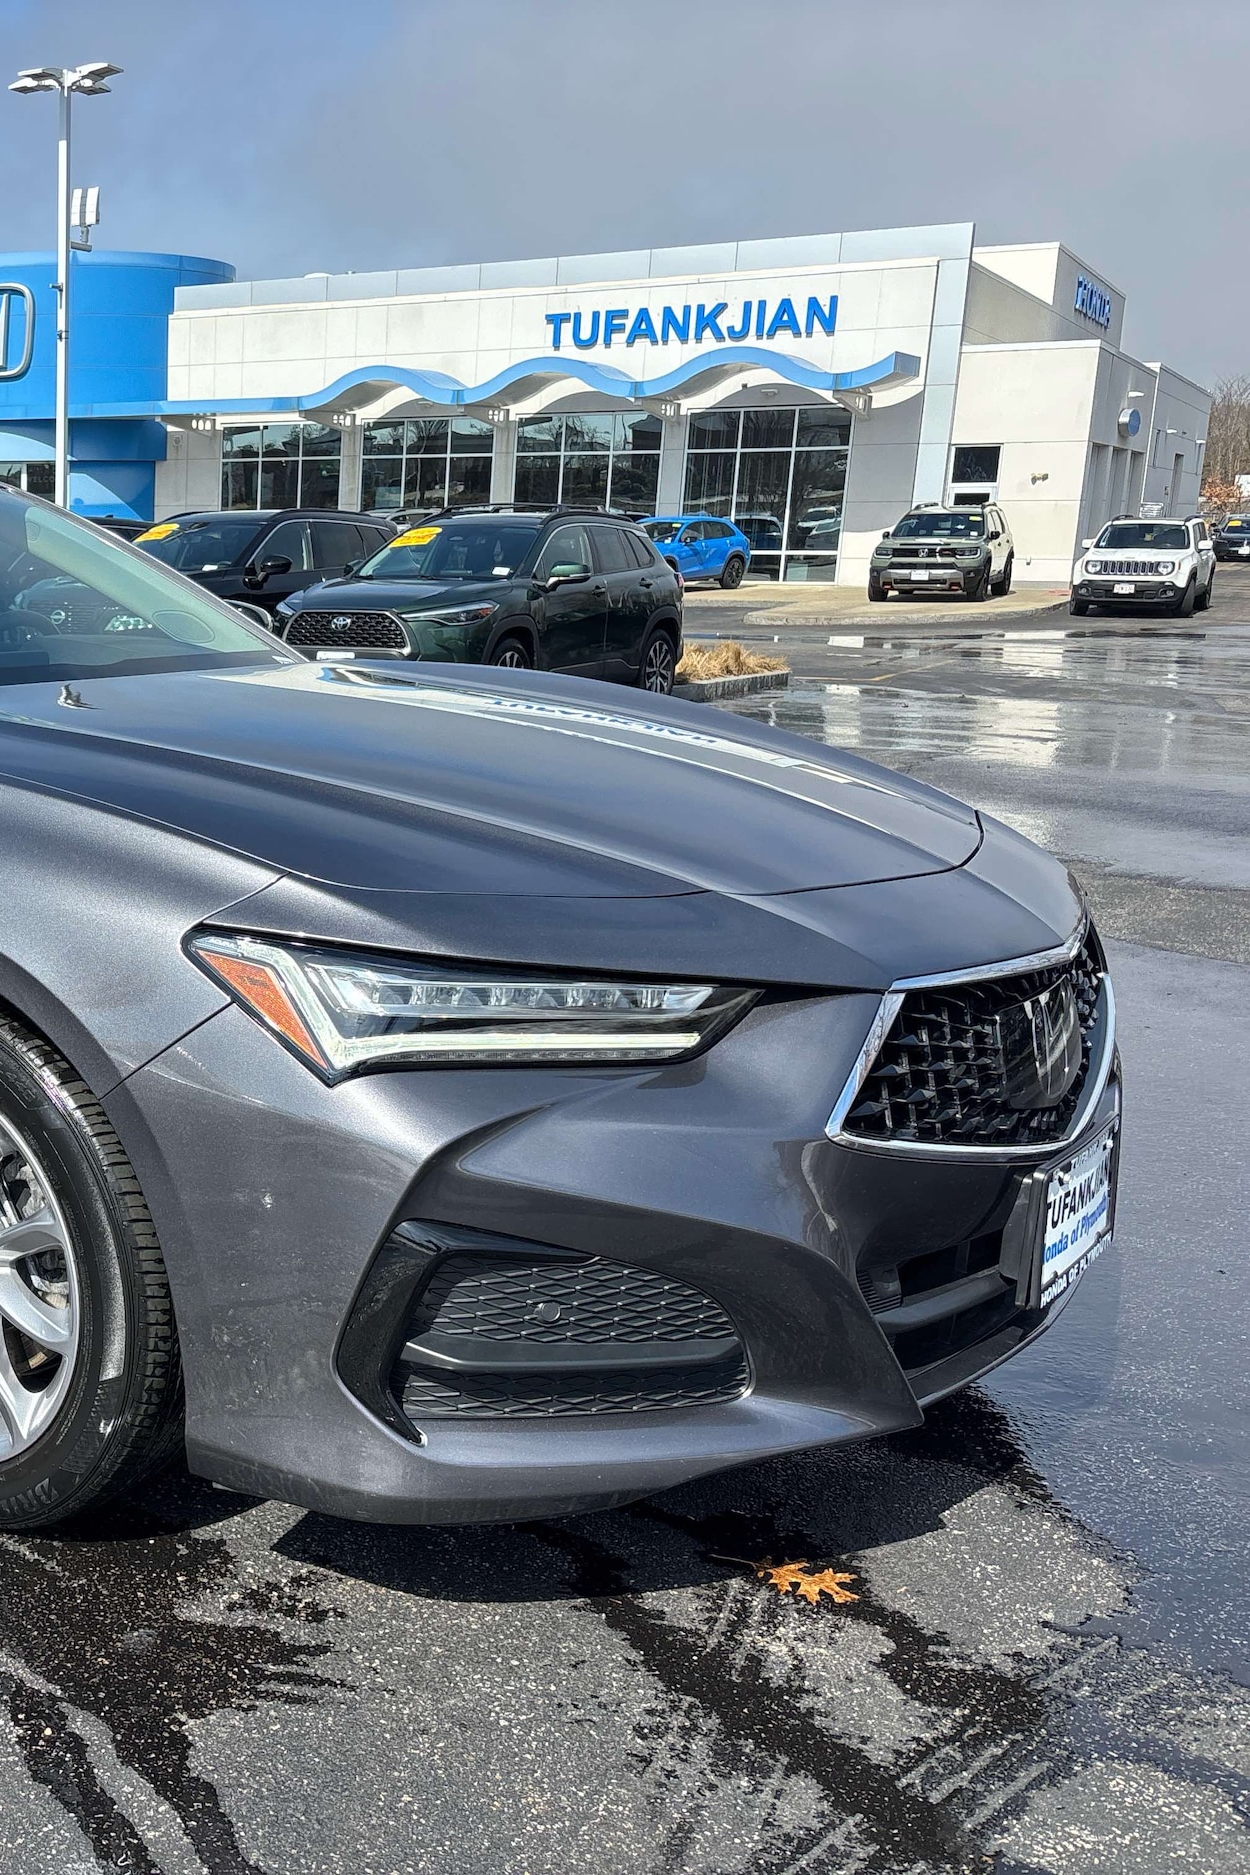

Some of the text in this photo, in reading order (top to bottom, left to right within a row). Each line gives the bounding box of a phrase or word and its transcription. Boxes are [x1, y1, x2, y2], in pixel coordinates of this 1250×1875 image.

[544, 295, 839, 350] TUFANKJIAN
[1044, 1231, 1069, 1264] onda
[1070, 1219, 1081, 1246] of
[1040, 1274, 1068, 1308] HONDA
[1068, 1263, 1079, 1284] OF
